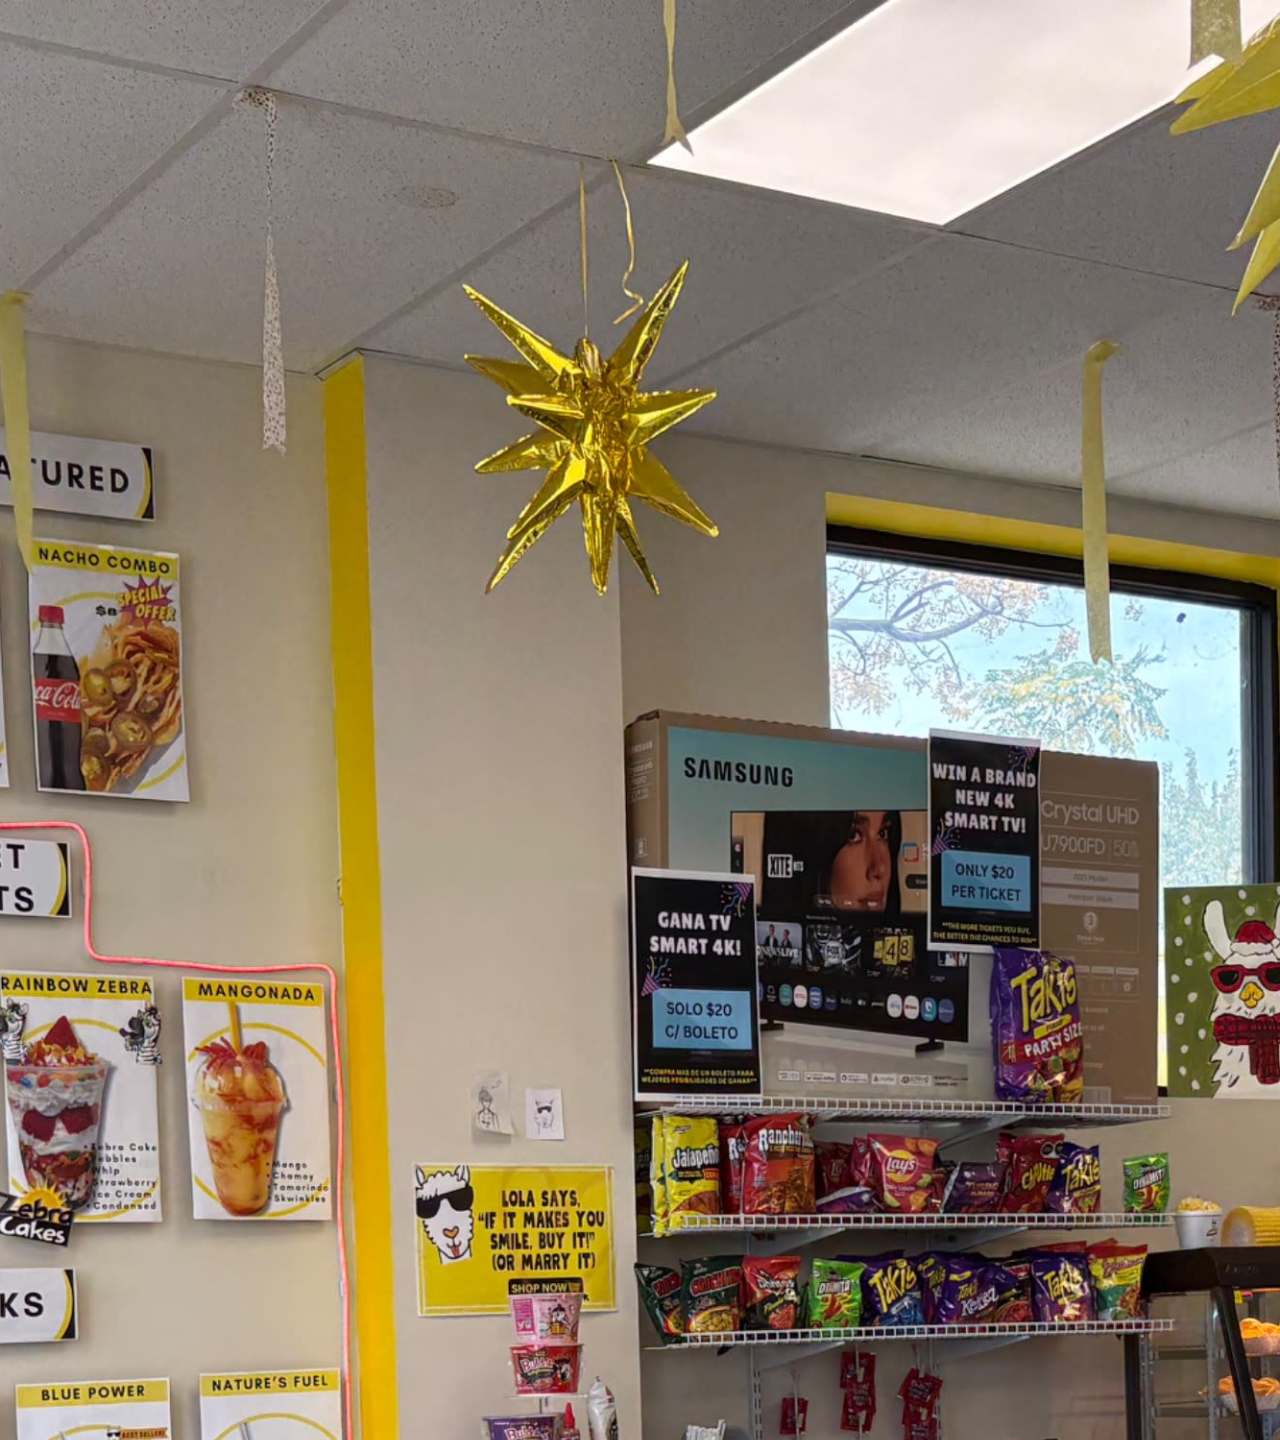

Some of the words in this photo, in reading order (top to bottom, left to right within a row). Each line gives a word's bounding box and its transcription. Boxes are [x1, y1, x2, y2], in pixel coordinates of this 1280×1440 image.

[39, 548, 100, 567] NACHO
[108, 555, 171, 574] COMBO
[120, 583, 165, 608] SPECIAL
[136, 604, 176, 621] OFFER
[684, 757, 794, 788] SAMSUNG
[932, 763, 967, 782] WIN
[971, 767, 981, 783] A
[985, 769, 1036, 788] BRAND
[955, 789, 991, 806] NEW
[994, 792, 1015, 809] 4K
[1041, 799, 1103, 823] Crystal
[1107, 804, 1139, 825] UHD
[944, 811, 998, 831] SMART
[1001, 815, 1027, 833] TV!
[769, 856, 792, 877] XITE
[955, 862, 990, 878] ONLY
[991, 866, 1015, 880] $20
[952, 885, 977, 899] PER
[979, 886, 1022, 902] TICKET
[658, 911, 705, 930] GANA
[709, 913, 732, 931] TV
[649, 936, 709, 955] SMART
[712, 939, 742, 956] 4K!
[1, 976, 90, 993] RAINBOW
[97, 979, 152, 994] ZEBRA
[199, 983, 315, 1001] MANGONADA
[666, 1002, 704, 1016] SOLO
[706, 1003, 732, 1016] $20
[665, 1025, 681, 1039] C/
[683, 1025, 738, 1040] BOLETO
[1024, 1033, 1063, 1058] PARTY
[501, 1190, 535, 1207] LOLA
[541, 1191, 580, 1207] SAYS,
[503, 1212, 517, 1228] IT
[523, 1211, 570, 1228] MAKES
[576, 1211, 605, 1226] YOU
[538, 1232, 565, 1249] BUY
[492, 1253, 515, 1271] (OR
[522, 1254, 570, 1271] MARRY
[577, 1253, 596, 1269] IT)
[511, 1284, 540, 1293] SHOP
[542, 1283, 568, 1292] NOW
[212, 1376, 287, 1392] NATURE'S
[293, 1374, 328, 1388] FUEL
[41, 1387, 82, 1401] BLUE
[88, 1384, 145, 1399] POWER
